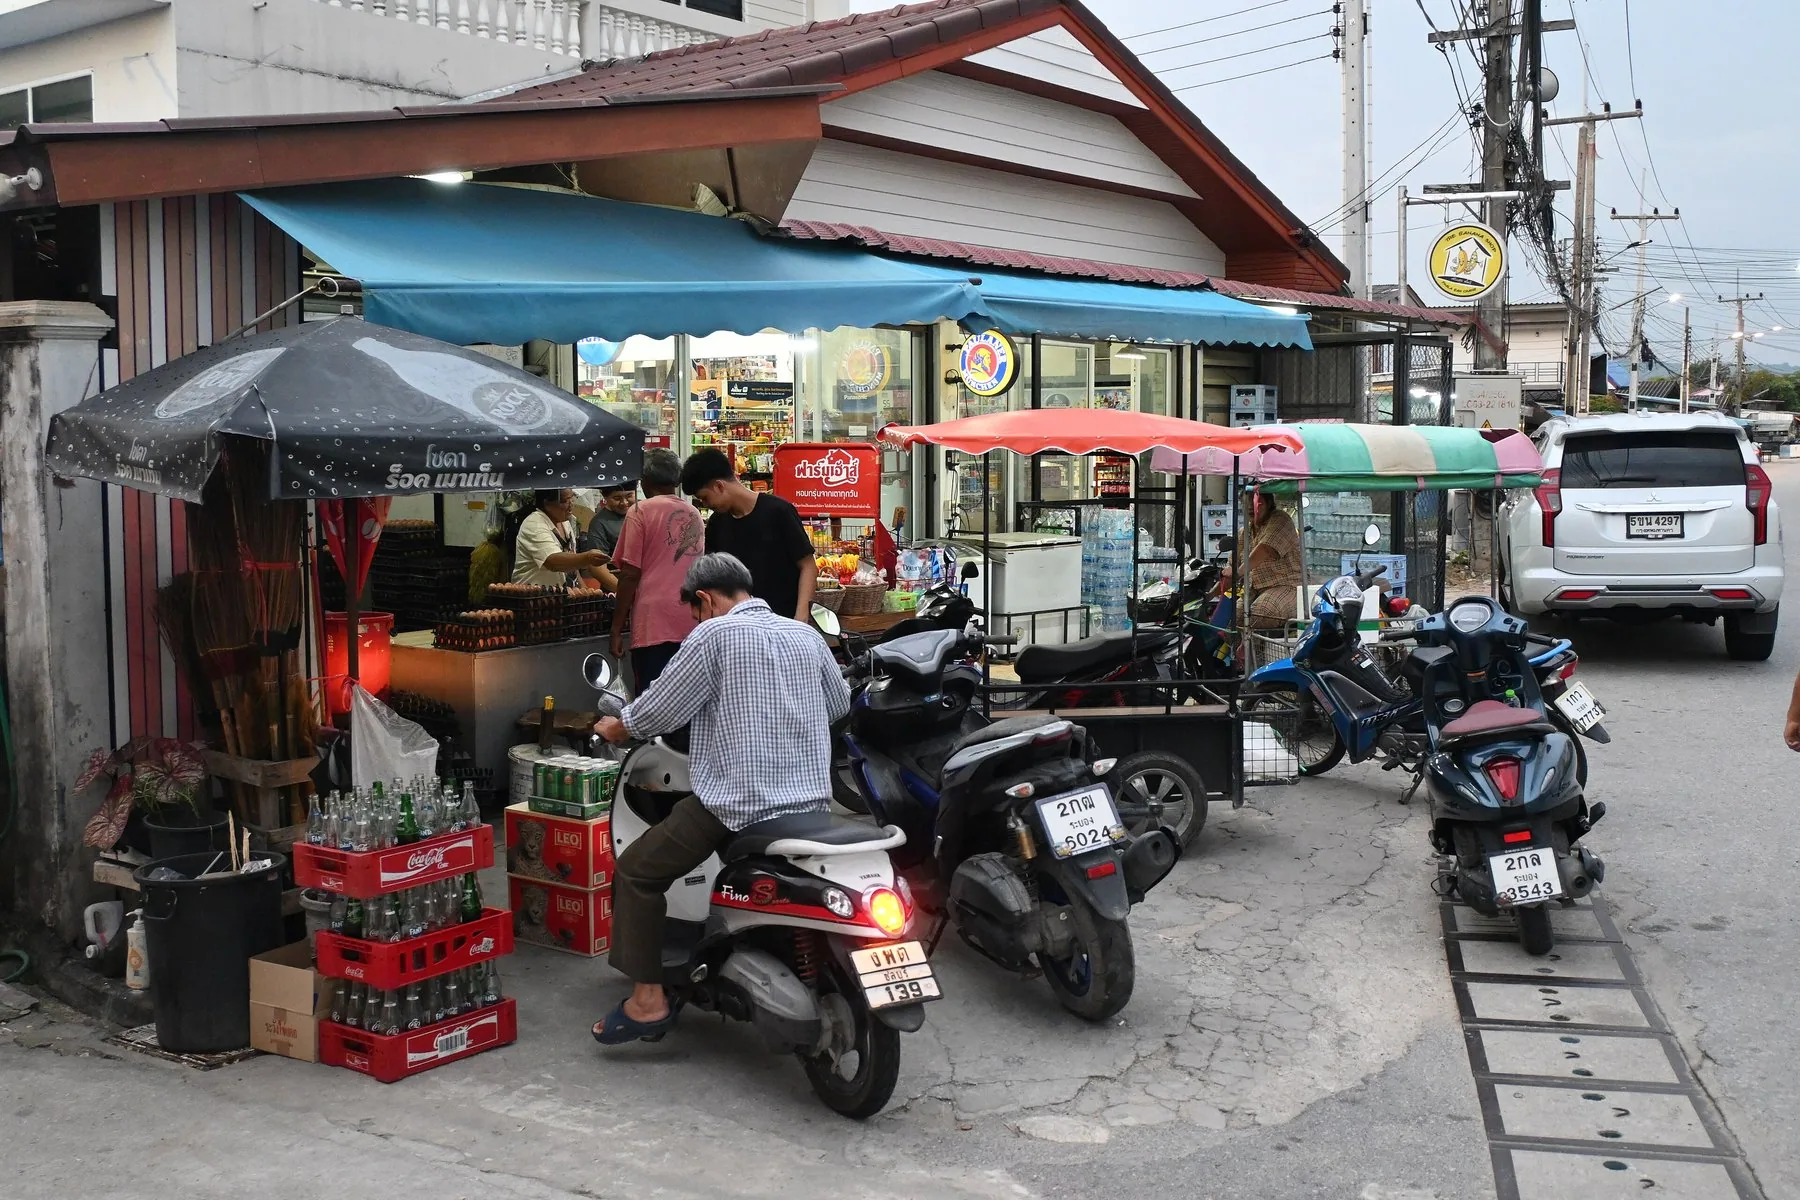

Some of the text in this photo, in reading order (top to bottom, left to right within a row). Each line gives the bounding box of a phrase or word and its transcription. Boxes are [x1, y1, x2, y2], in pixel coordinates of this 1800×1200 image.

[1459, 230, 1484, 239] BANANA
[128, 436, 148, 462] โซดา
[425, 443, 467, 469] โซดา
[384, 462, 505, 489] ร็อค เมาเท็น
[794, 457, 860, 484] ฟาร์มเฮ้าส์
[795, 488, 858, 500] หอมกรุ่นจากเตาทุกวัน
[1654, 516, 1680, 527] 4297
[556, 832, 580, 846] LEO
[1064, 825, 1111, 851] 6024
[407, 848, 445, 870] Coca-Cola
[1514, 872, 1538, 883] ระยอง
[721, 884, 749, 903] Fino
[1506, 882, 1554, 900] 3543
[558, 899, 581, 913] LEO
[885, 982, 923, 1001] 139
